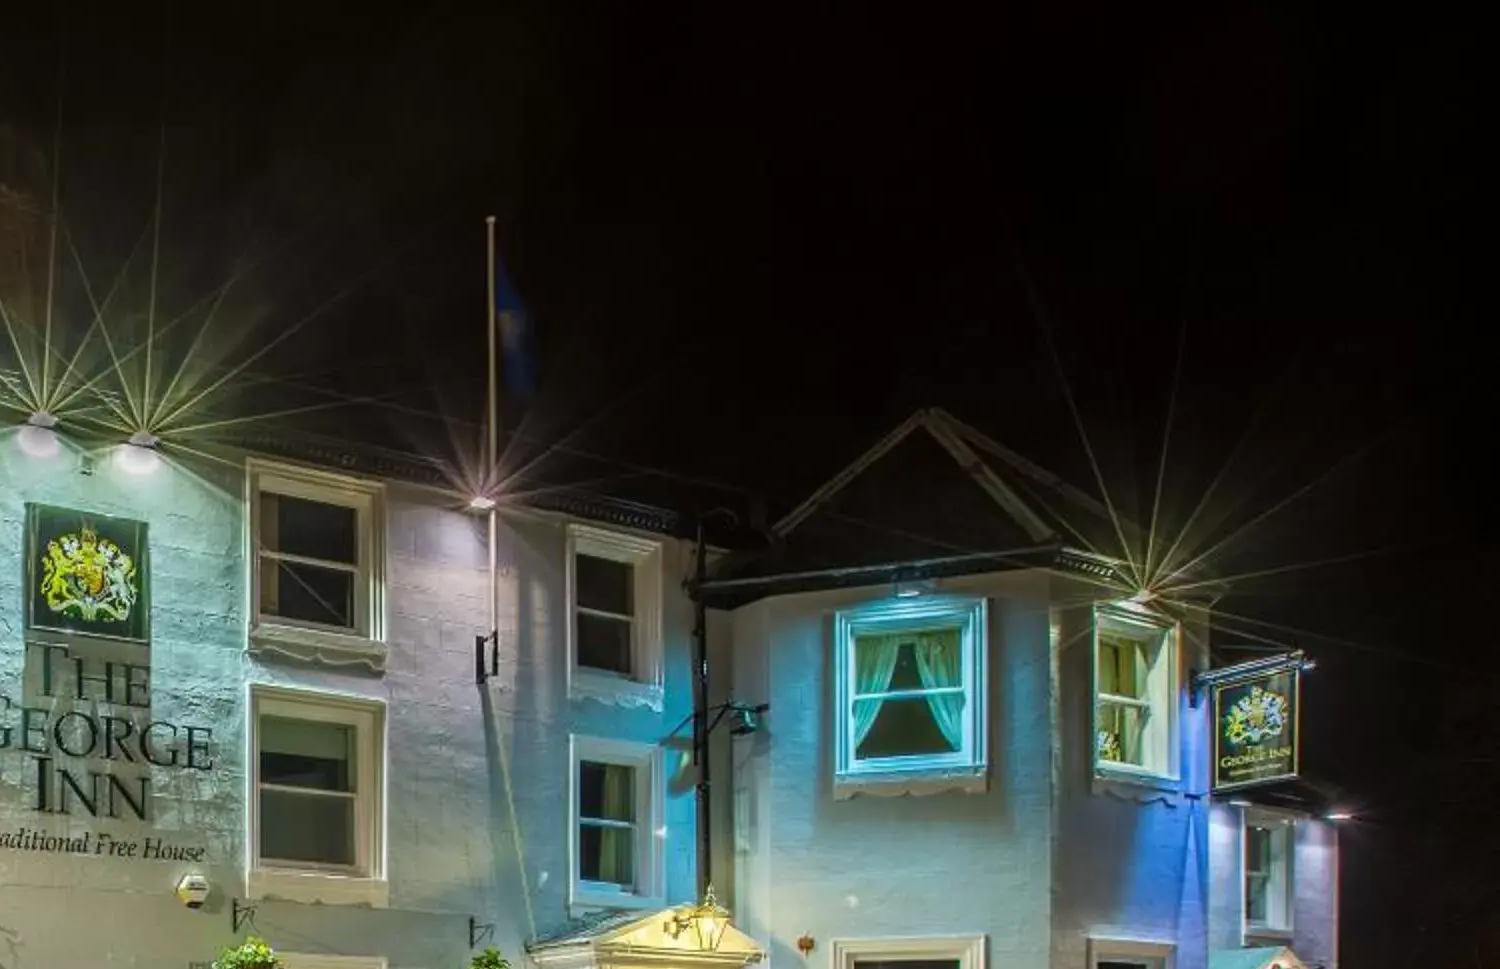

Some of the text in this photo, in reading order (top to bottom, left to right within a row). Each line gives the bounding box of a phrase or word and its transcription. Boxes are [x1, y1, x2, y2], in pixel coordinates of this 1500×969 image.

[25, 640, 150, 708] THE
[31, 752, 151, 821] INN
[95, 833, 138, 858] Free
[142, 836, 206, 863] House
